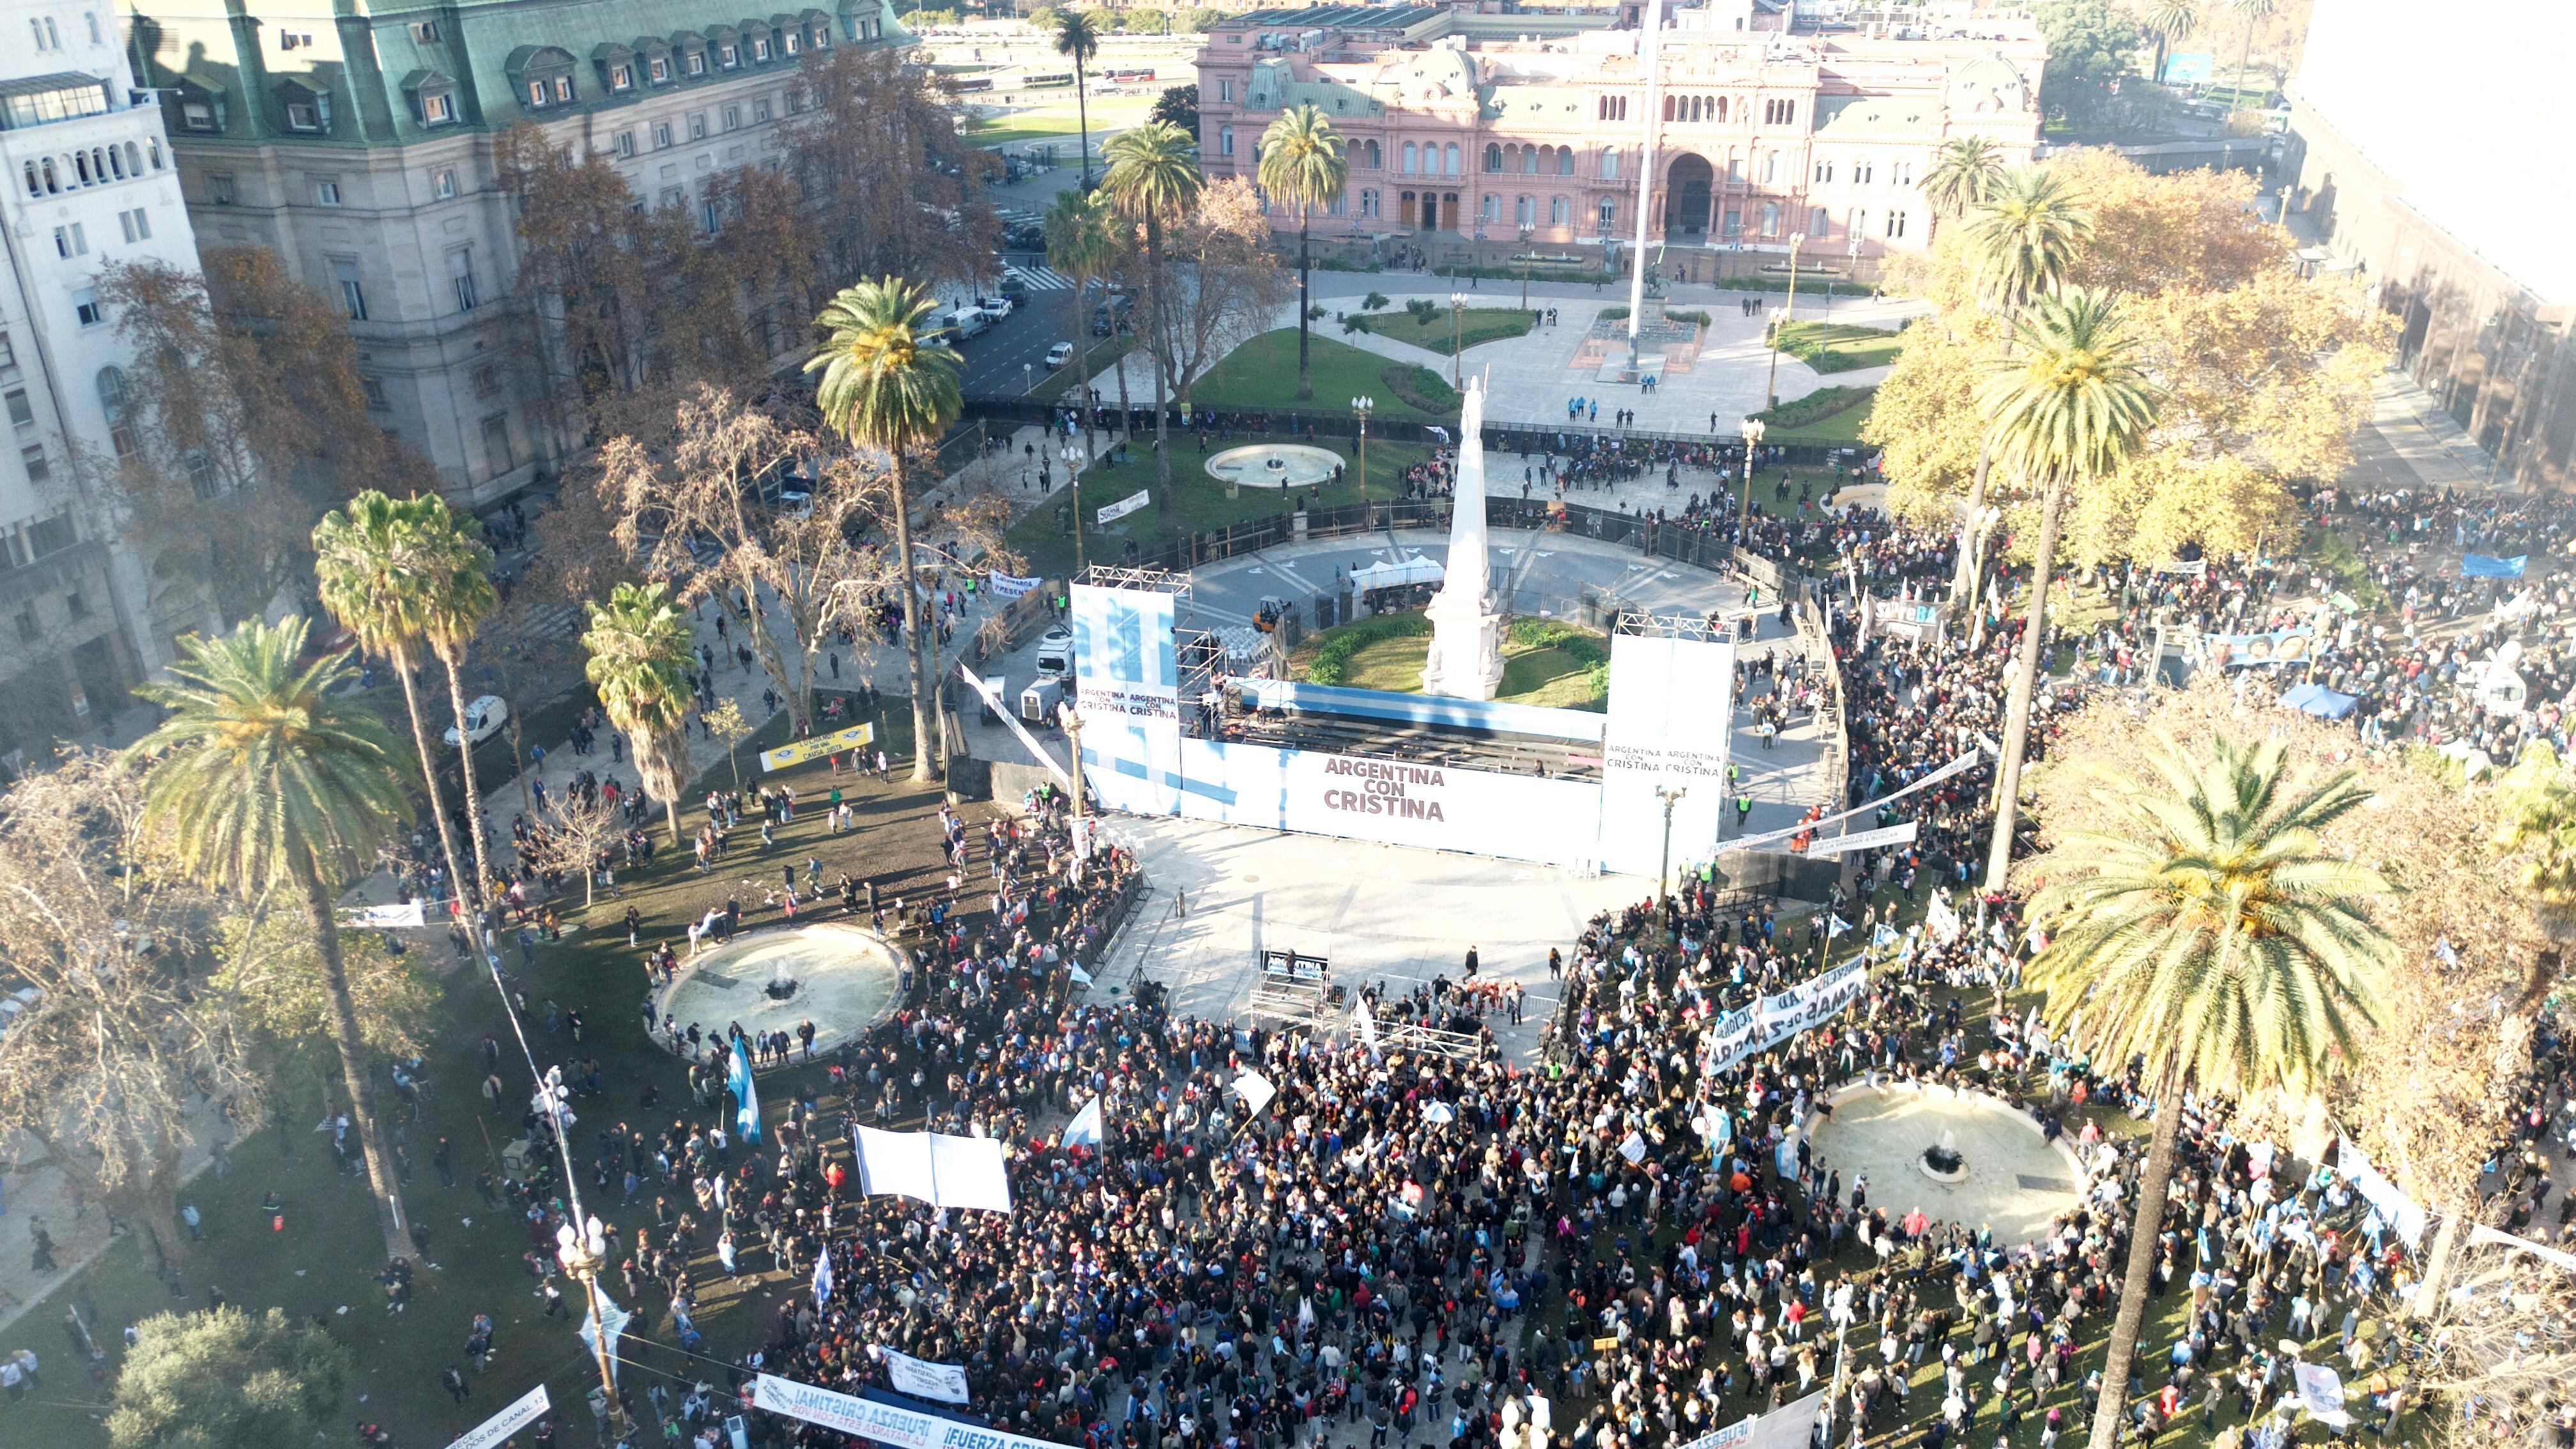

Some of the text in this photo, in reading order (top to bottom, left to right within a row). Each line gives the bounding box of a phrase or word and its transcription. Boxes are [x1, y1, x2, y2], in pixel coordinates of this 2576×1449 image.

[1081, 689, 1125, 698] ARGENTINA
[1130, 694, 1176, 705] ARGENTINA
[1080, 701, 1126, 713] CRISTINA
[1130, 707, 1176, 719] CRISTINA
[803, 744, 843, 760] CAUSA JUSTA
[1609, 745, 1661, 757] ARGENTINA
[1667, 751, 1720, 762] ARGENTINA
[1325, 758, 1445, 786] ARGENTINA
[1607, 759, 1660, 772] CRISTINA
[1666, 764, 1719, 777] CRISTINA
[1363, 779, 1404, 797] CON
[1324, 789, 1444, 822] CRISTINA
[487, 1425, 500, 1438] DE
[502, 1404, 533, 1427] CANAL
[534, 1395, 544, 1405] 13
